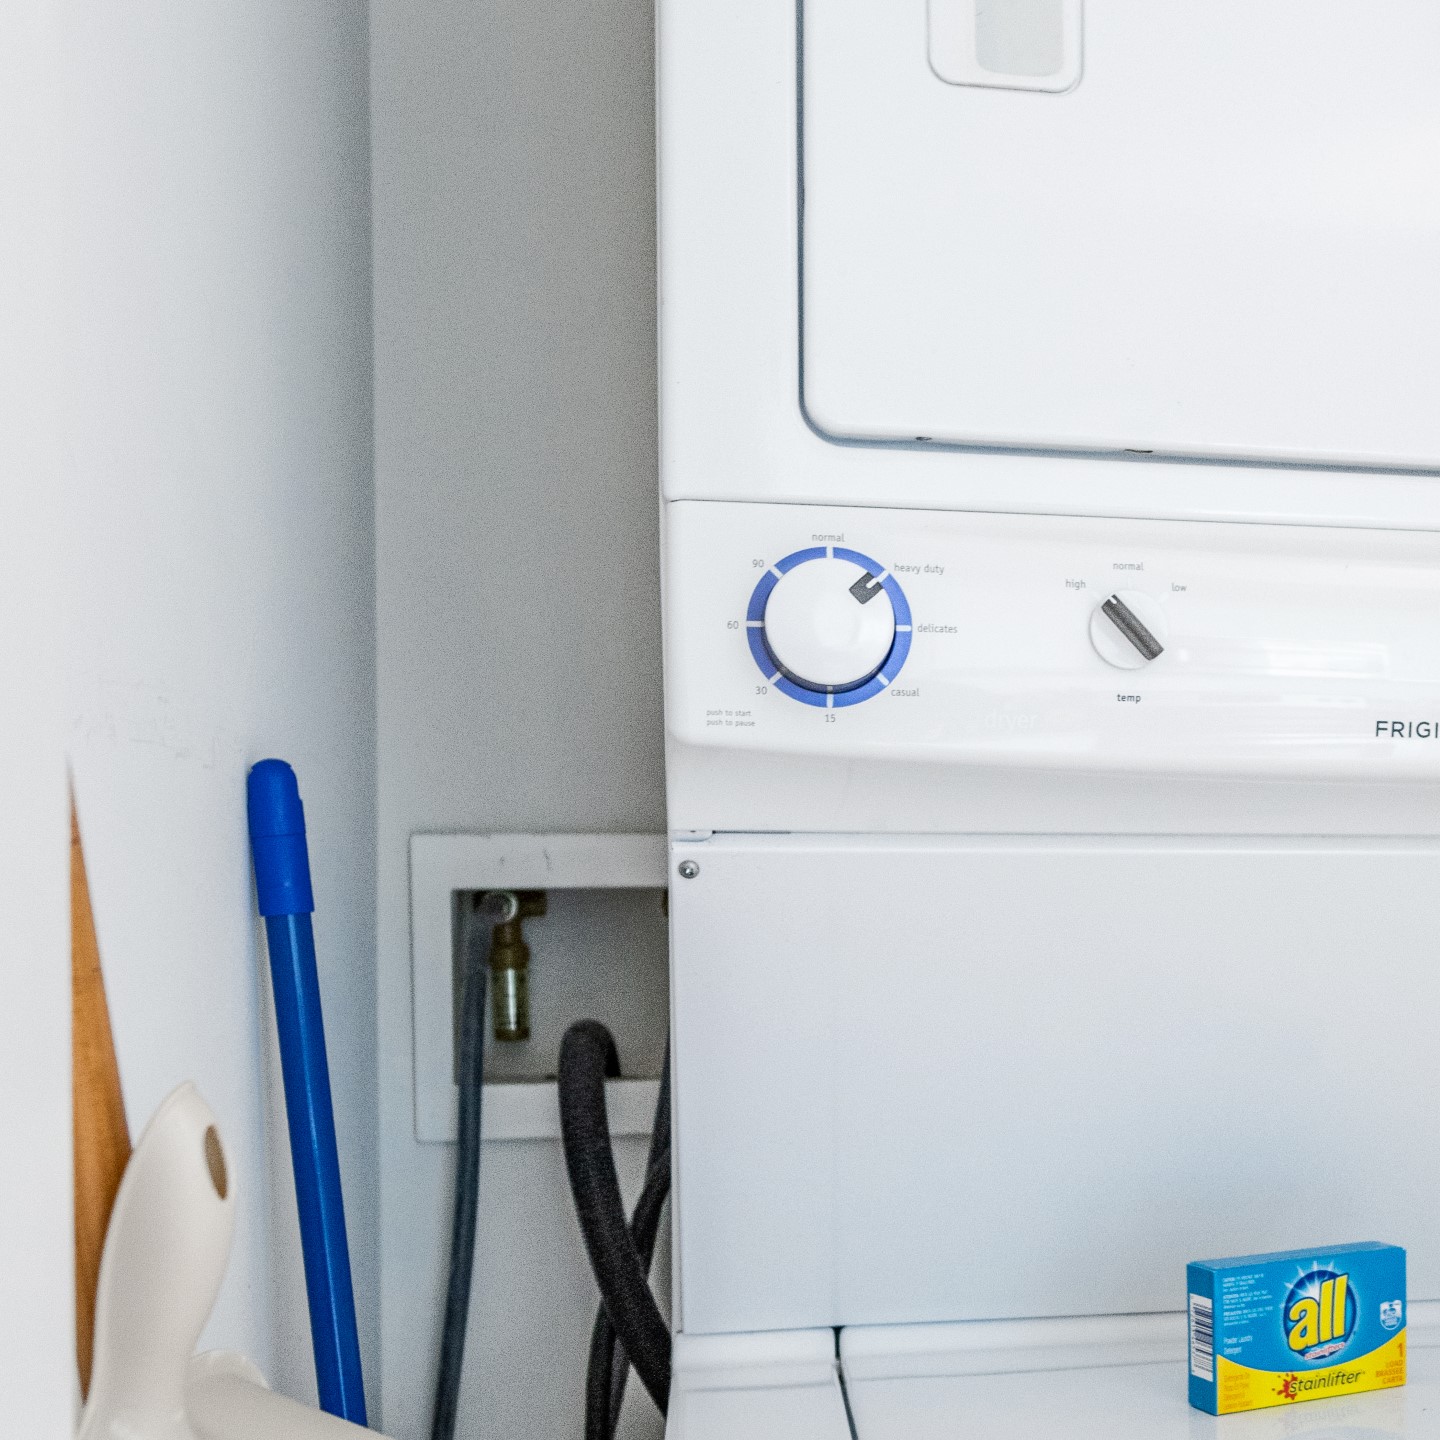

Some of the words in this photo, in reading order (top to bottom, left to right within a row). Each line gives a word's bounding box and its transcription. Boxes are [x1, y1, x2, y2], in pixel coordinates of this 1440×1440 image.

[811, 533, 845, 542] normal
[752, 559, 764, 568] 90
[1112, 562, 1144, 571] normal
[894, 563, 921, 574] heavy
[923, 564, 944, 575] duty
[1065, 579, 1086, 591] high
[1171, 582, 1187, 592] low
[727, 620, 739, 630] 60
[917, 624, 958, 634] delicates
[755, 686, 767, 696] 30
[891, 688, 920, 697] casual
[1117, 693, 1142, 704] temp
[706, 709, 723, 719] push
[825, 713, 836, 723] 15
[706, 719, 723, 728] push
[984, 708, 1039, 731] dryer
[1288, 1273, 1349, 1352] all
[1398, 1342, 1404, 1358] 1
[1289, 1371, 1362, 1394] stainlifter
